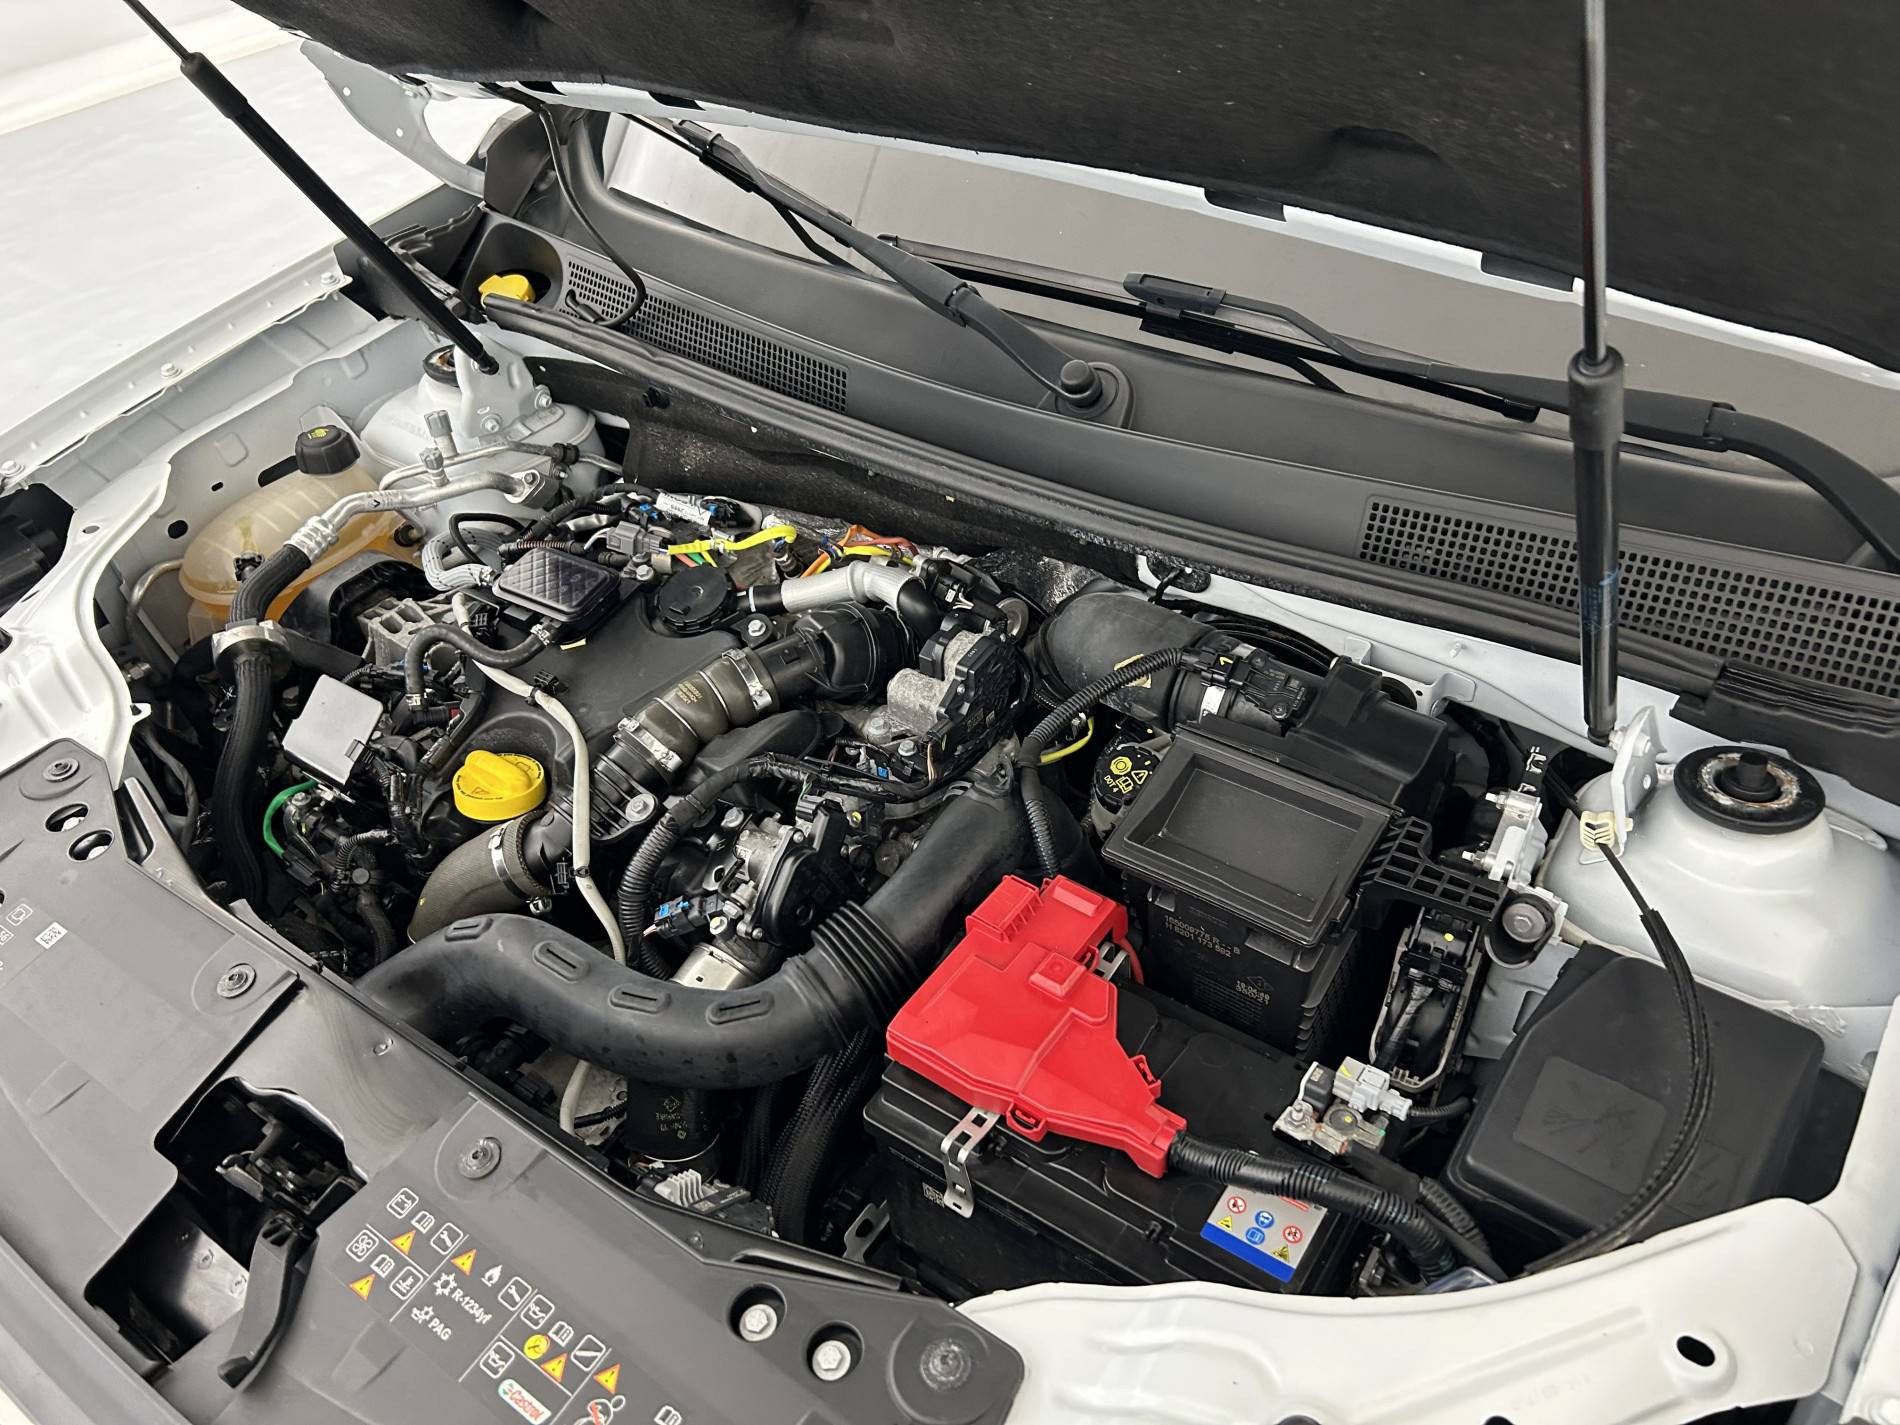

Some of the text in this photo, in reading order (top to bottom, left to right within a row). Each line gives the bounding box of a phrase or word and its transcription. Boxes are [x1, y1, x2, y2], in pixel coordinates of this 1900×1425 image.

[1104, 775, 1116, 787] DOT
[451, 1288, 493, 1325] R-1234yf
[428, 1317, 452, 1341] PAG
[509, 1389, 545, 1420] Castrol
